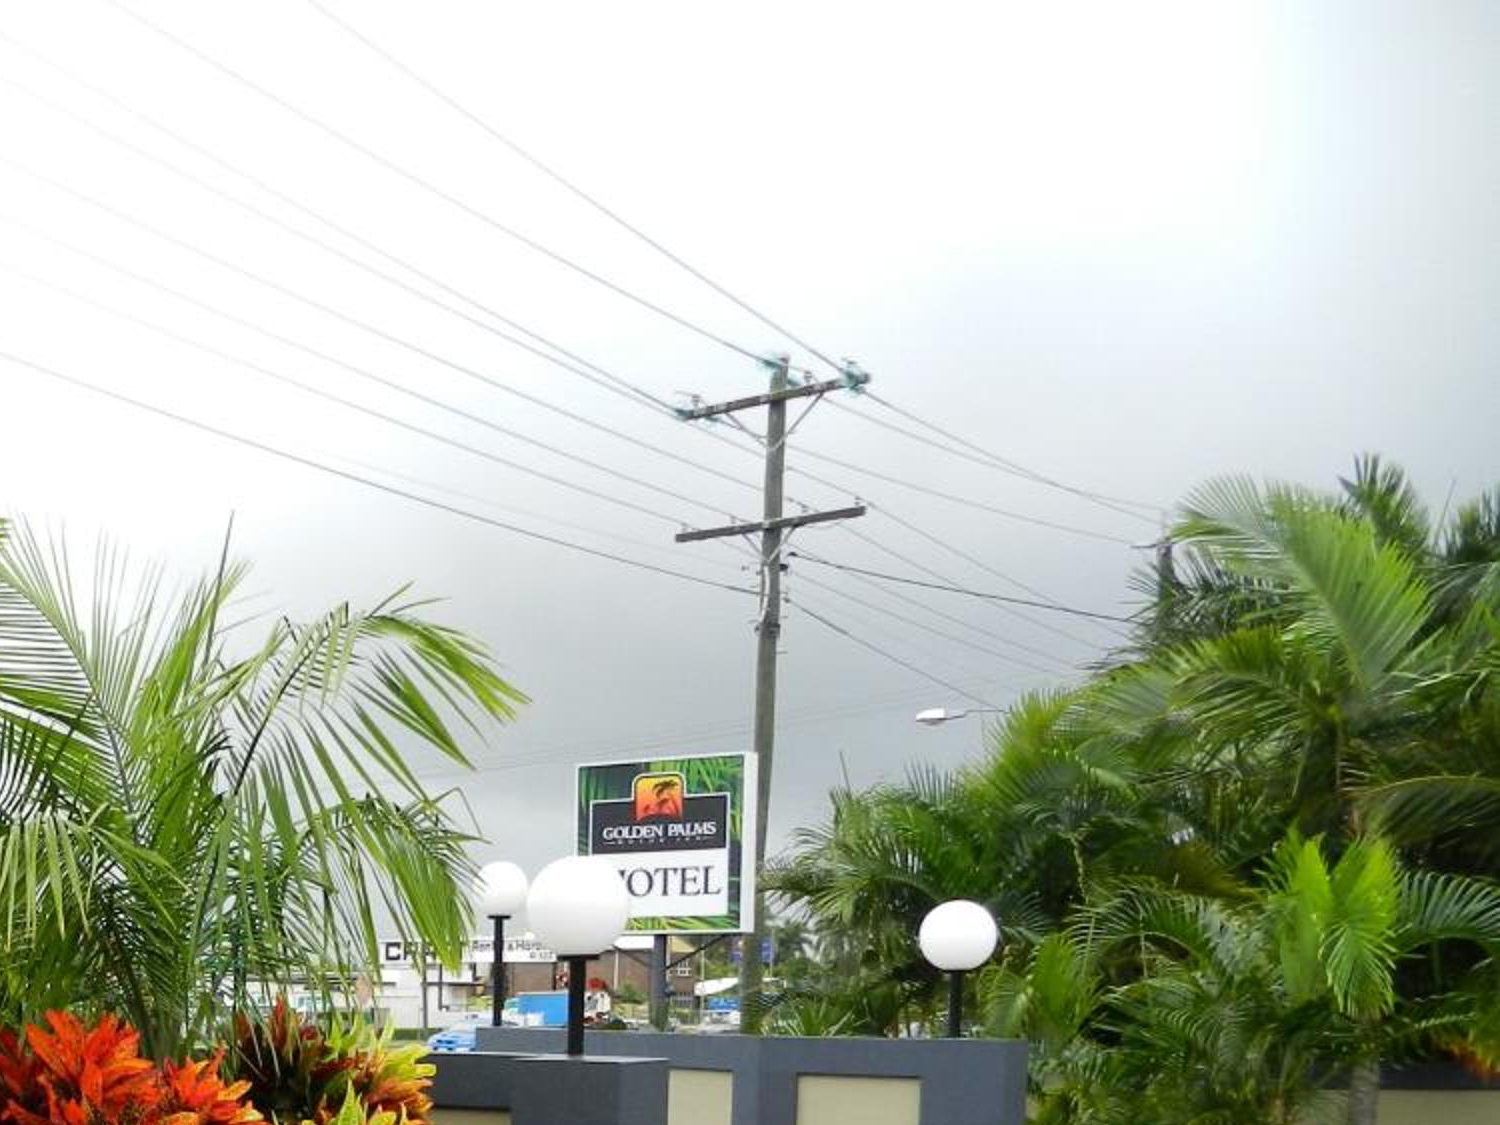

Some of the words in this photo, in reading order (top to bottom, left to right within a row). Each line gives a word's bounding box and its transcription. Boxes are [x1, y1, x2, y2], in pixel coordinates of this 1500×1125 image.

[602, 825, 664, 840] GOLDEN
[667, 821, 718, 837] PALMS
[618, 864, 722, 897] OTEL
